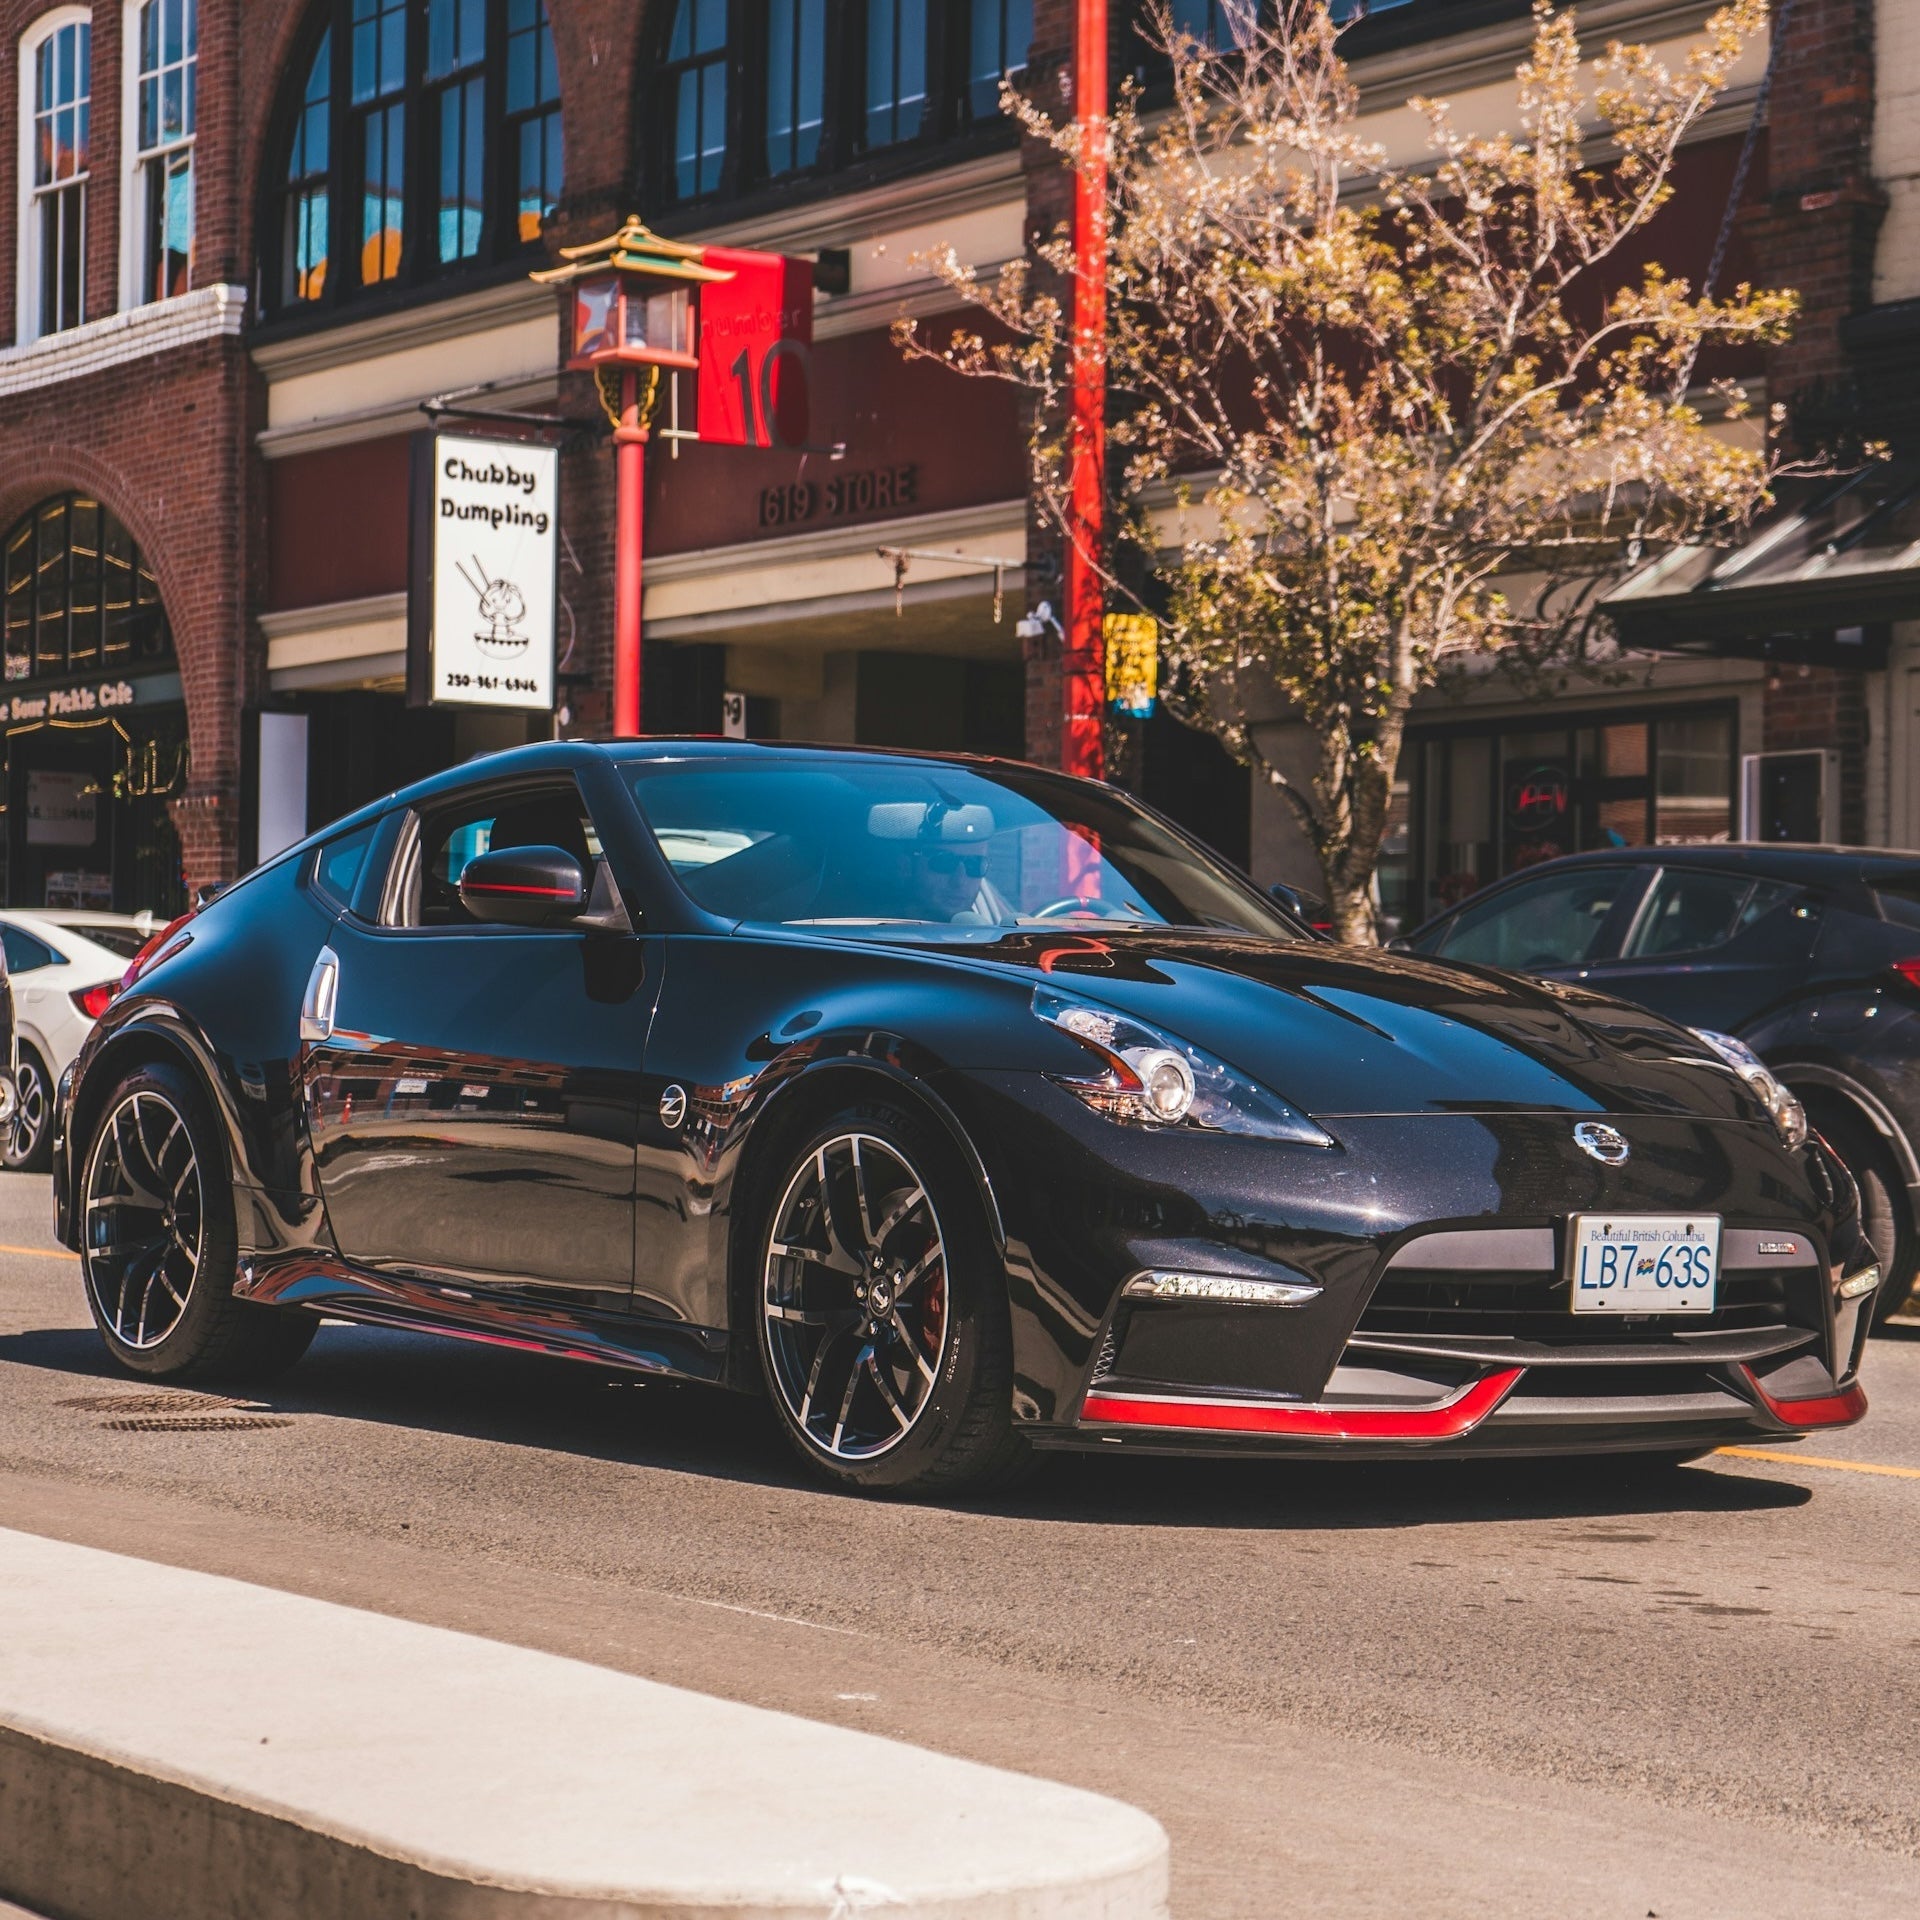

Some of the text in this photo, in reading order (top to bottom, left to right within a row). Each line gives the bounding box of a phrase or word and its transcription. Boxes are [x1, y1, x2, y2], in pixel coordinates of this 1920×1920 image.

[731, 338, 812, 450] 10
[445, 458, 535, 494] Chubby
[826, 464, 917, 516] STORE
[441, 498, 548, 534] Dumpling
[11, 697, 46, 719] Sour
[49, 687, 95, 715] Pickle
[99, 681, 132, 707] Cafe
[1591, 1230, 1705, 1241] Beautiful British Columbia
[1581, 1245, 1711, 1289] LB7 63S
